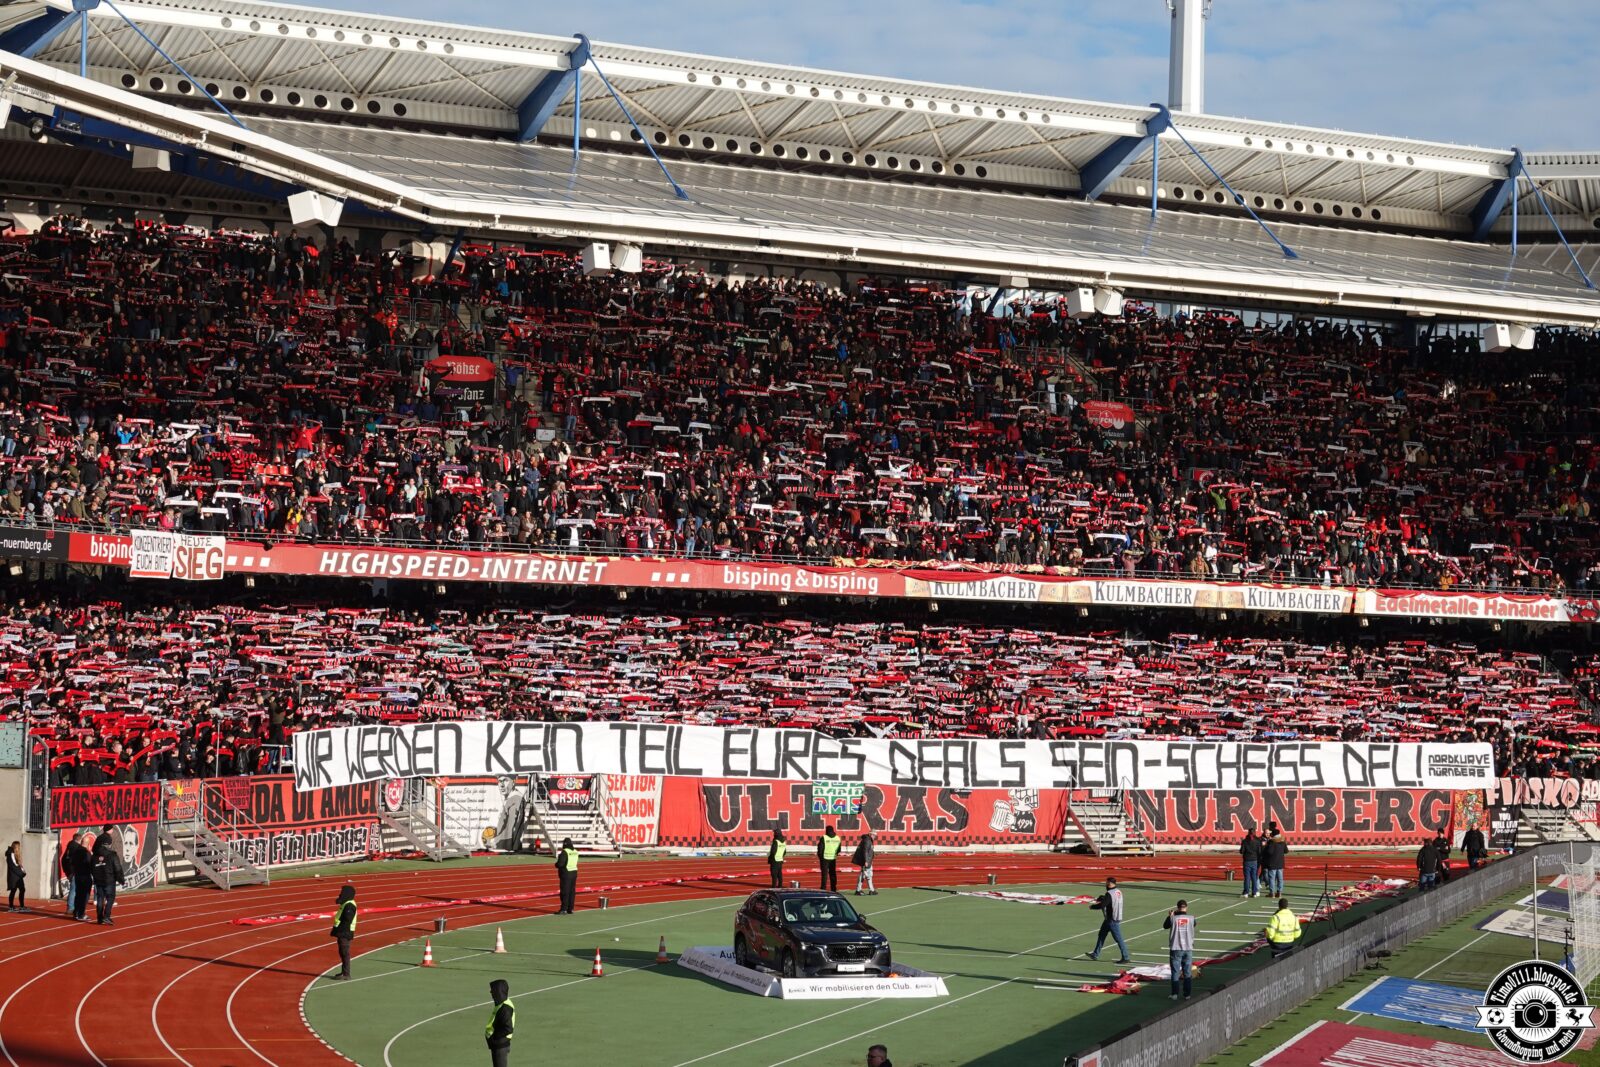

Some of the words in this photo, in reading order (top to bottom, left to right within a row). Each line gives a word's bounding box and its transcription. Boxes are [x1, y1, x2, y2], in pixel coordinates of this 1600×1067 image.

[181, 535, 212, 546] HEUTE
[136, 553, 152, 570] EUCH
[175, 546, 223, 579] SIEG
[319, 551, 607, 582] HIGHSPEED-INTERNET
[723, 565, 791, 591] bisping
[795, 570, 808, 586] &
[812, 571, 878, 593] bisping
[1095, 581, 1192, 604] KULMBACHER
[1248, 587, 1340, 610] KULMBACHER
[1484, 598, 1558, 618] Hanauer
[294, 730, 333, 789] WIR
[344, 723, 462, 782] WERDEN
[485, 722, 584, 773] KEIN
[609, 723, 703, 775] TEIL
[723, 729, 865, 781] EURES
[889, 740, 1025, 787] DEALS
[1051, 740, 1325, 788] SEIN-SCHEISS
[1343, 744, 1423, 787] DFL!
[321, 780, 377, 818] AMICI
[559, 792, 579, 805] RSR
[1486, 777, 1580, 808] FIASKO
[52, 791, 90, 825] KAOS
[105, 786, 157, 820] BAGAGE
[606, 798, 655, 817] STADION
[825, 983, 874, 992] mobilisieren
[876, 982, 891, 991] den
